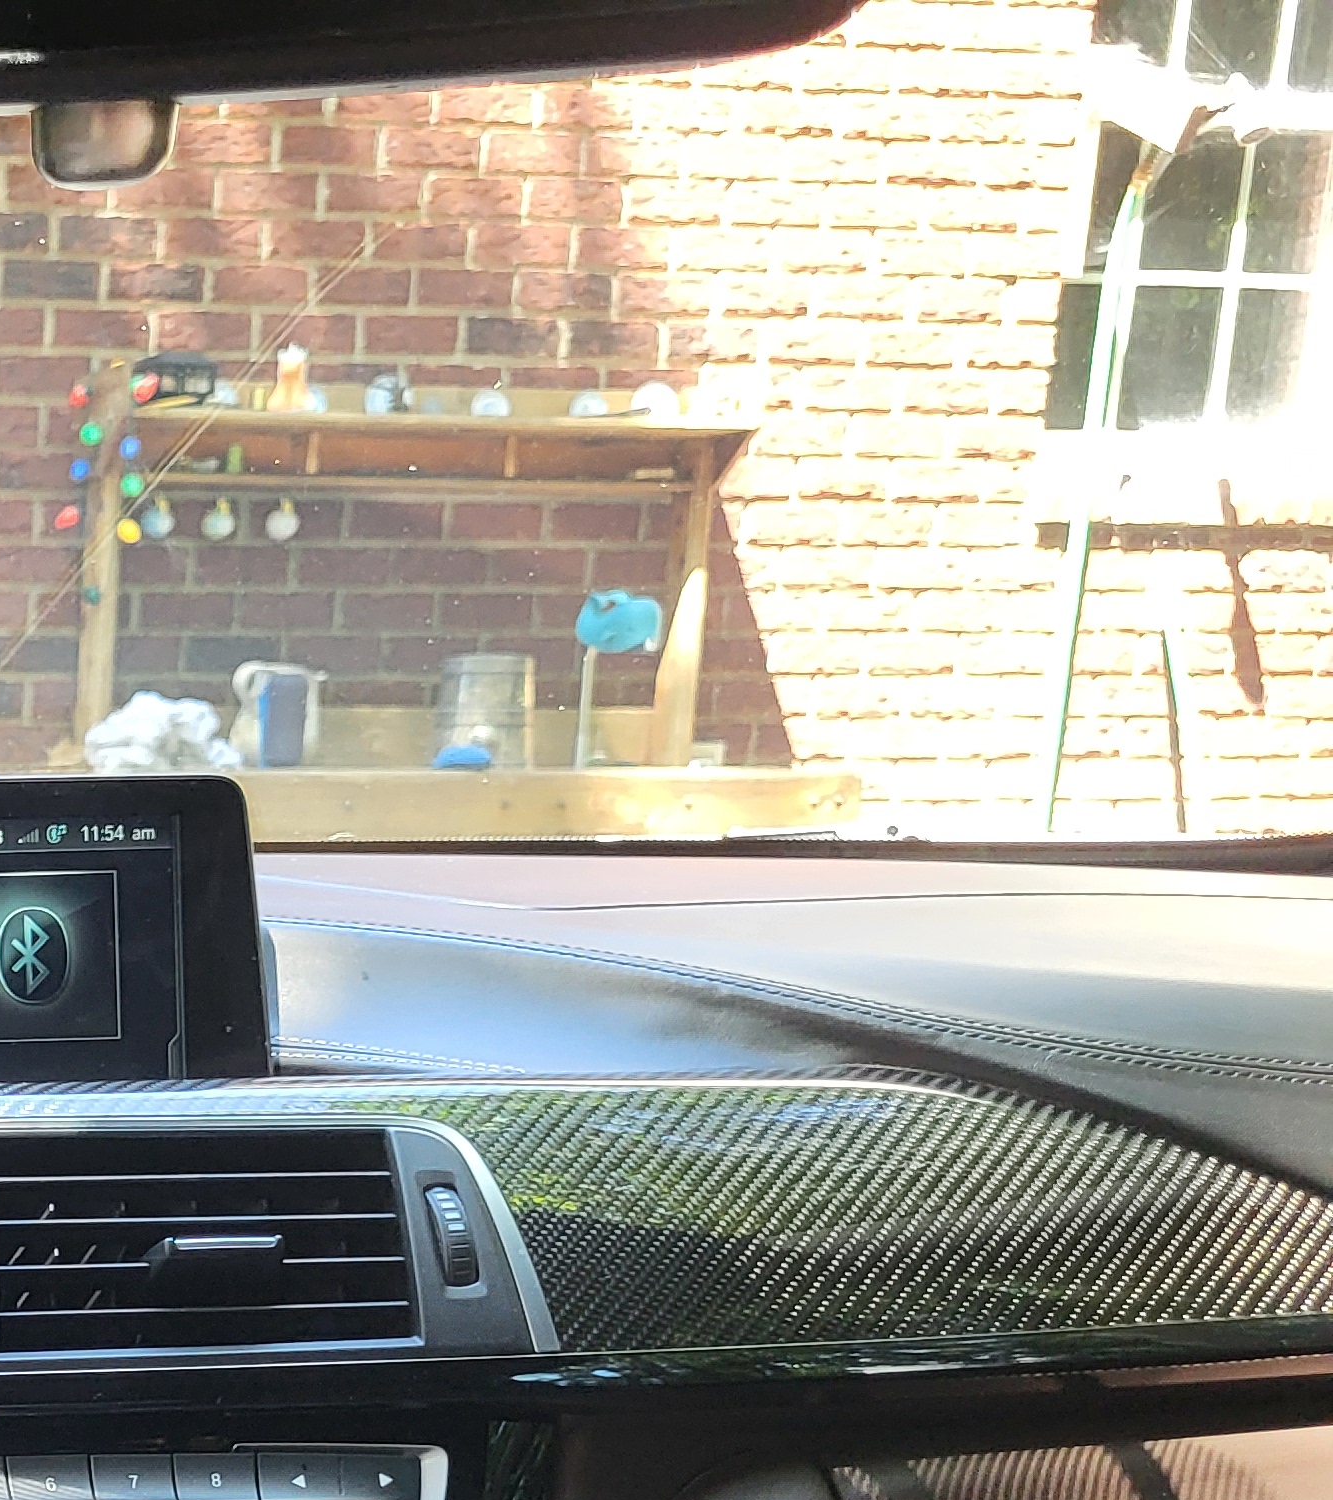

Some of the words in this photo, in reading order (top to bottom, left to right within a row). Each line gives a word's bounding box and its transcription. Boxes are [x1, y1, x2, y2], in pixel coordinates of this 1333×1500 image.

[80, 825, 125, 842] 11:54
[131, 827, 156, 840] am
[44, 1477, 57, 1492] 6
[127, 1474, 140, 1489] 7
[210, 1472, 222, 1488] 8
